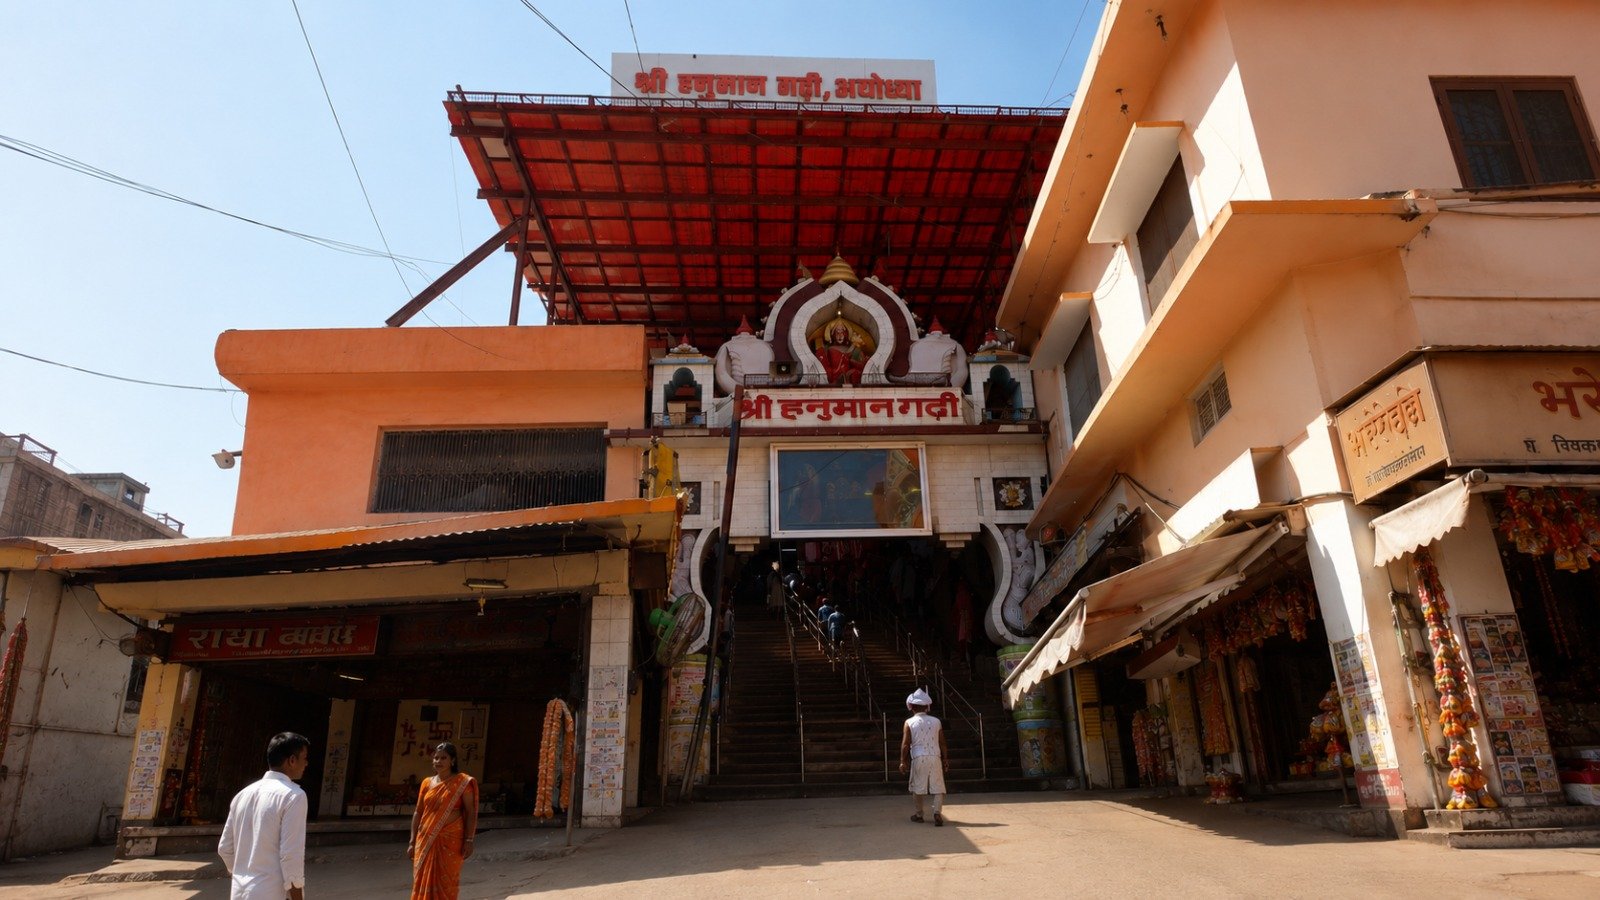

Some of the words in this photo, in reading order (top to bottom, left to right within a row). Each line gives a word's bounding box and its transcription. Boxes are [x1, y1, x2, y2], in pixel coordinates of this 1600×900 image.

[634, 67, 669, 95] श्री
[677, 73, 768, 101] हनुमान
[835, 72, 922, 100] अयोध्या
[740, 394, 773, 420] श्री
